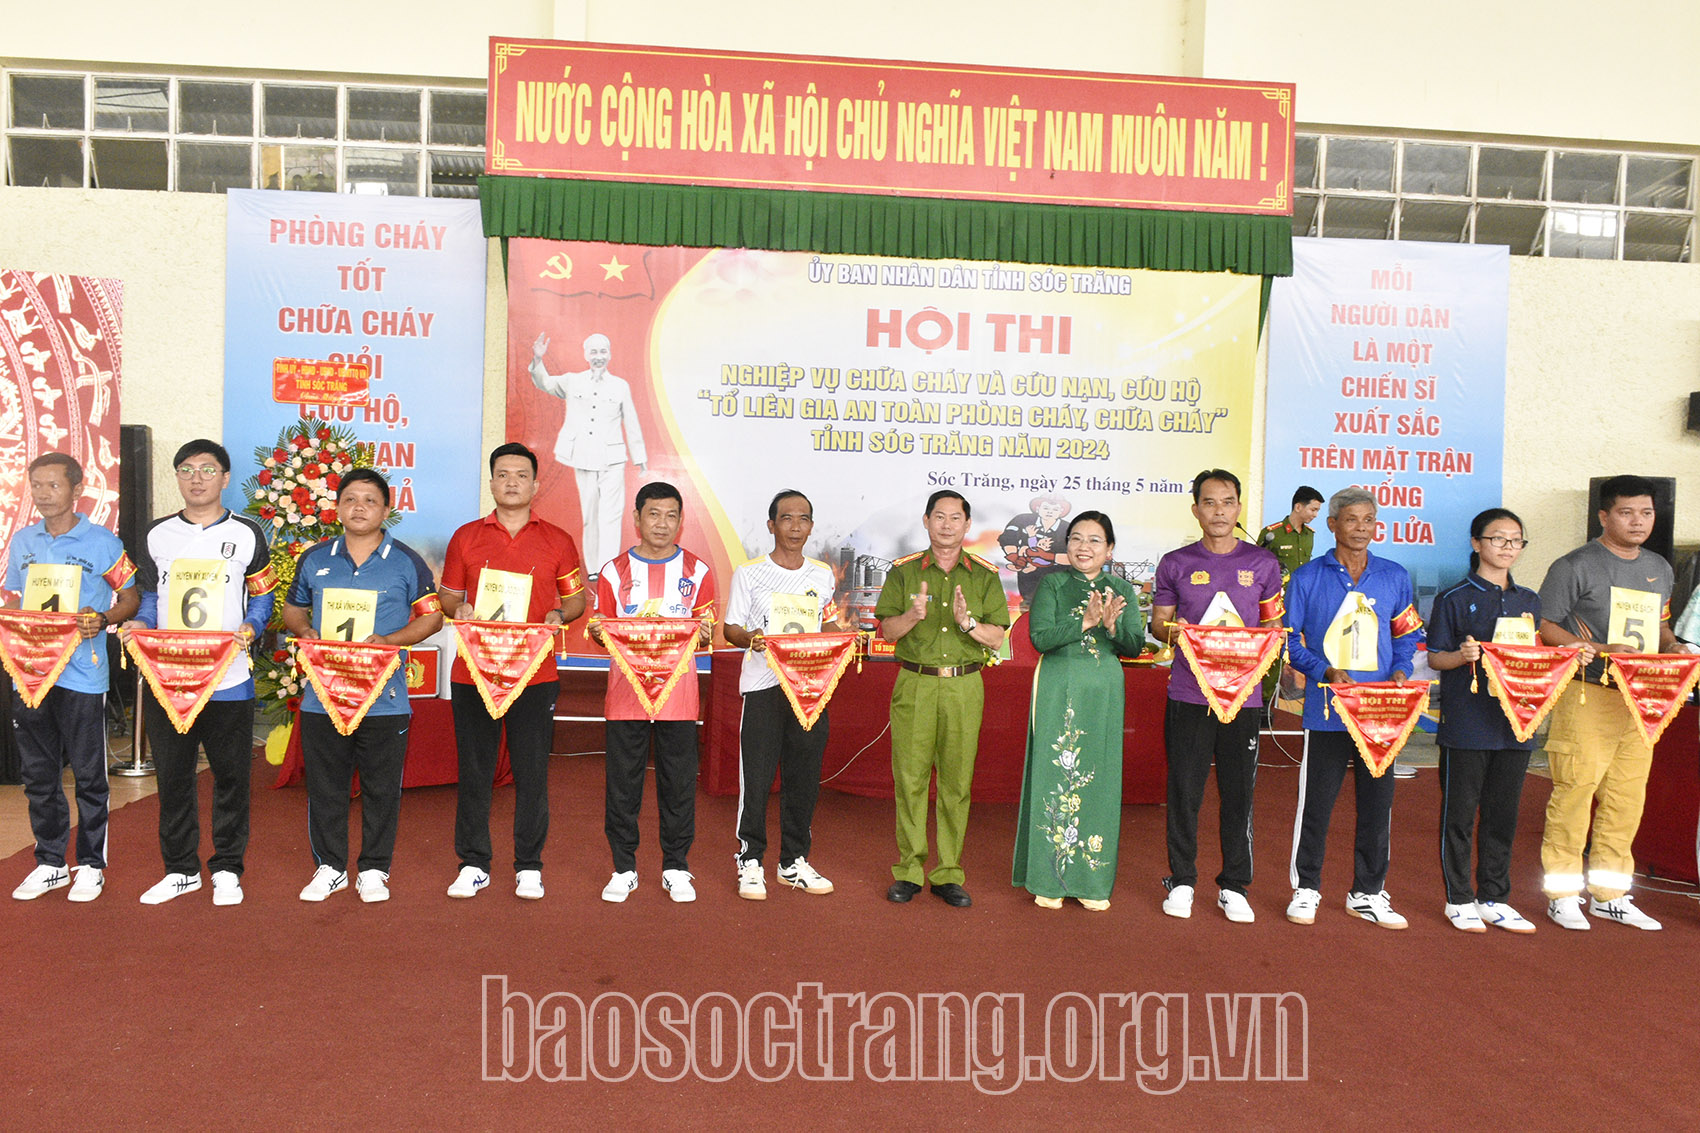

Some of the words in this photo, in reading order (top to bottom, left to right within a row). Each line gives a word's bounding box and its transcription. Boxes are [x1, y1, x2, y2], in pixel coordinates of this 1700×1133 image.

[515, 65, 592, 146] NƯỚC
[600, 71, 673, 161] CỘNG
[680, 73, 733, 153] HÒA
[740, 80, 776, 155] XÃ
[784, 82, 829, 171] HỘI
[836, 79, 889, 162] CHỦ
[896, 88, 975, 166] NGHĨA
[983, 94, 1037, 182] VIỆT
[1043, 110, 1104, 173] NAM
[1110, 102, 1187, 178] MUÔN
[1193, 107, 1252, 181] NĂM
[1260, 122, 1269, 181] !
[269, 214, 365, 247] PHÒNG
[374, 219, 447, 251] CHÁY
[337, 257, 386, 292] TỐT
[808, 257, 833, 283] ỦY
[837, 263, 877, 285] BAN
[881, 263, 934, 287] NHÂN
[939, 264, 977, 289] DÂN
[982, 264, 1024, 291] TỈNH
[1029, 268, 1067, 293] SÓC
[1071, 271, 1132, 296] TRĂNG
[1371, 264, 1412, 292] MỖI
[278, 303, 353, 335] CHỮA
[361, 306, 435, 338] CHÁY
[866, 306, 970, 355] HỘI
[985, 312, 1072, 355] THI
[1330, 301, 1398, 327] NGƯỜI
[1405, 304, 1449, 329] DÂN
[1353, 337, 1379, 362] LÀ
[1386, 338, 1433, 368] MỘT
[721, 362, 804, 391] NGHIỆP
[811, 367, 840, 393] VỤ
[846, 366, 906, 392] CHỮA
[912, 369, 970, 394] CHÁY
[977, 370, 1005, 395] VÀ
[1011, 372, 1056, 397] CỨU
[1062, 377, 1115, 402] NẠN,
[1121, 376, 1165, 401] CỨU
[1171, 378, 1200, 406] HỘ
[1341, 371, 1407, 400] CHIẾN
[1414, 376, 1437, 400] SĨ
[744, 393, 793, 418] LIÊN
[800, 399, 837, 420] GIA
[843, 400, 875, 421] AN
[882, 398, 940, 424] TOÀN
[946, 400, 1022, 427] PHÒNG
[1028, 404, 1088, 431] CHÁY,
[1095, 406, 1152, 431] CHỮA
[1334, 406, 1390, 434] XUẤT
[1397, 407, 1440, 436] SẮC
[811, 424, 863, 452] TỈNH
[869, 429, 915, 454] SÓC
[920, 431, 993, 457] TRĂNG
[999, 433, 1051, 458] NĂM
[1056, 438, 1110, 460] 2024
[1299, 444, 1354, 469] TRÊN
[1362, 446, 1409, 475] MẶT
[1416, 448, 1472, 477] TRẬN
[927, 470, 955, 487] Sóc
[961, 474, 1015, 491] Trăng,
[1020, 476, 1057, 493] ngày
[1063, 476, 1081, 490] 25
[1086, 475, 1131, 495] tháng
[1135, 478, 1145, 492] 5
[1149, 477, 1183, 494] năm
[1393, 516, 1434, 543] LỬA
[181, 587, 208, 629] 6
[1342, 620, 1360, 660] 1
[1623, 617, 1645, 653] 5
